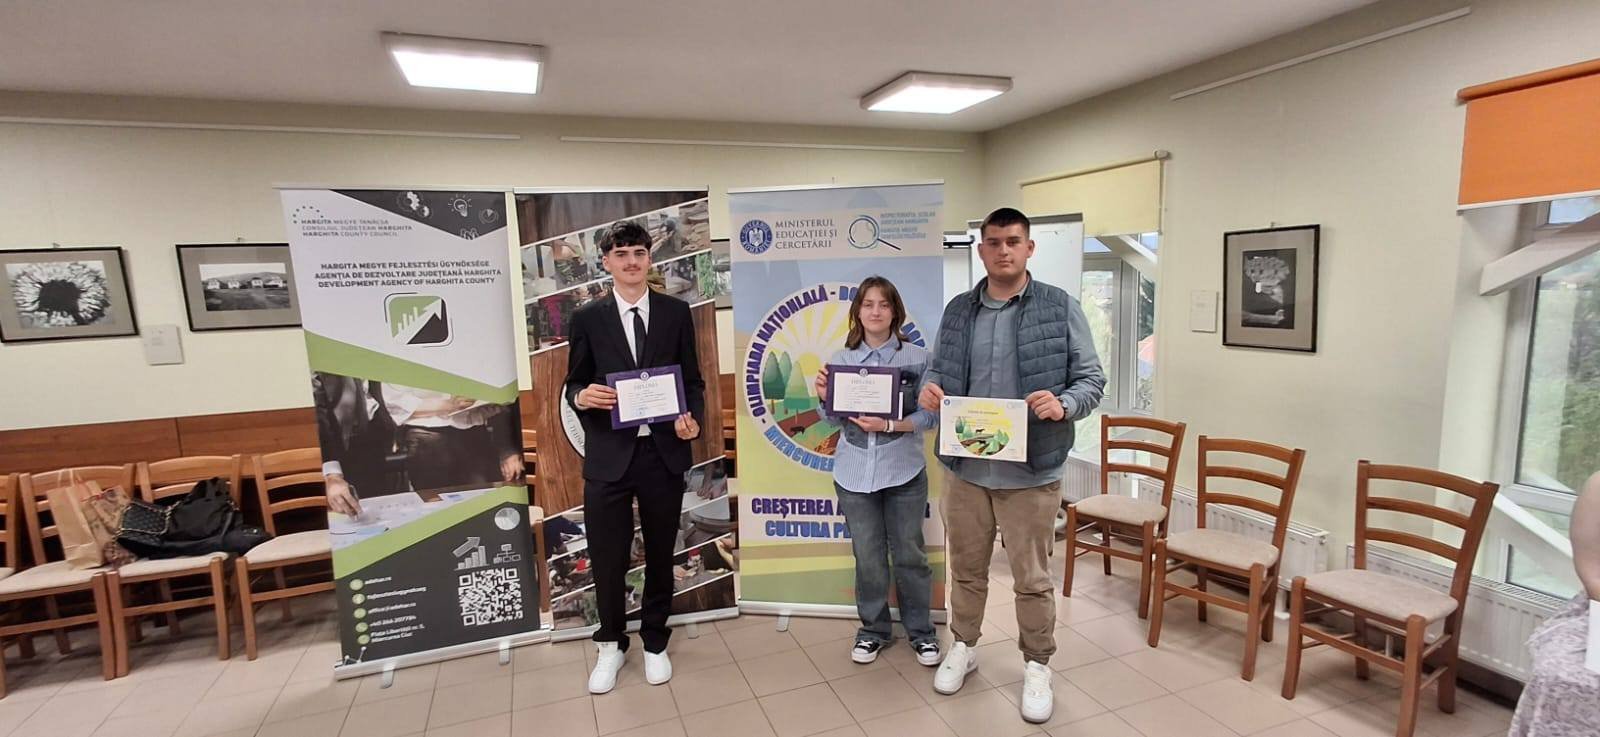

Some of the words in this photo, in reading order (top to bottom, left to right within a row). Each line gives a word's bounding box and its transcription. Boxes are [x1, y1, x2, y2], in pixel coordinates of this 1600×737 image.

[775, 220, 834, 228] MINISTERUL
[776, 230, 828, 240] EDUCAȚIEI
[829, 229, 837, 239] ȘI
[775, 240, 832, 249] CERCETĂRII
[315, 272, 350, 280] AGENȚIA
[418, 268, 463, 278] JUDEȚEANĂ
[746, 342, 766, 417] OLIMPIADA
[752, 498, 834, 518] CREȘTEREA
[766, 520, 830, 538] CULTURA
